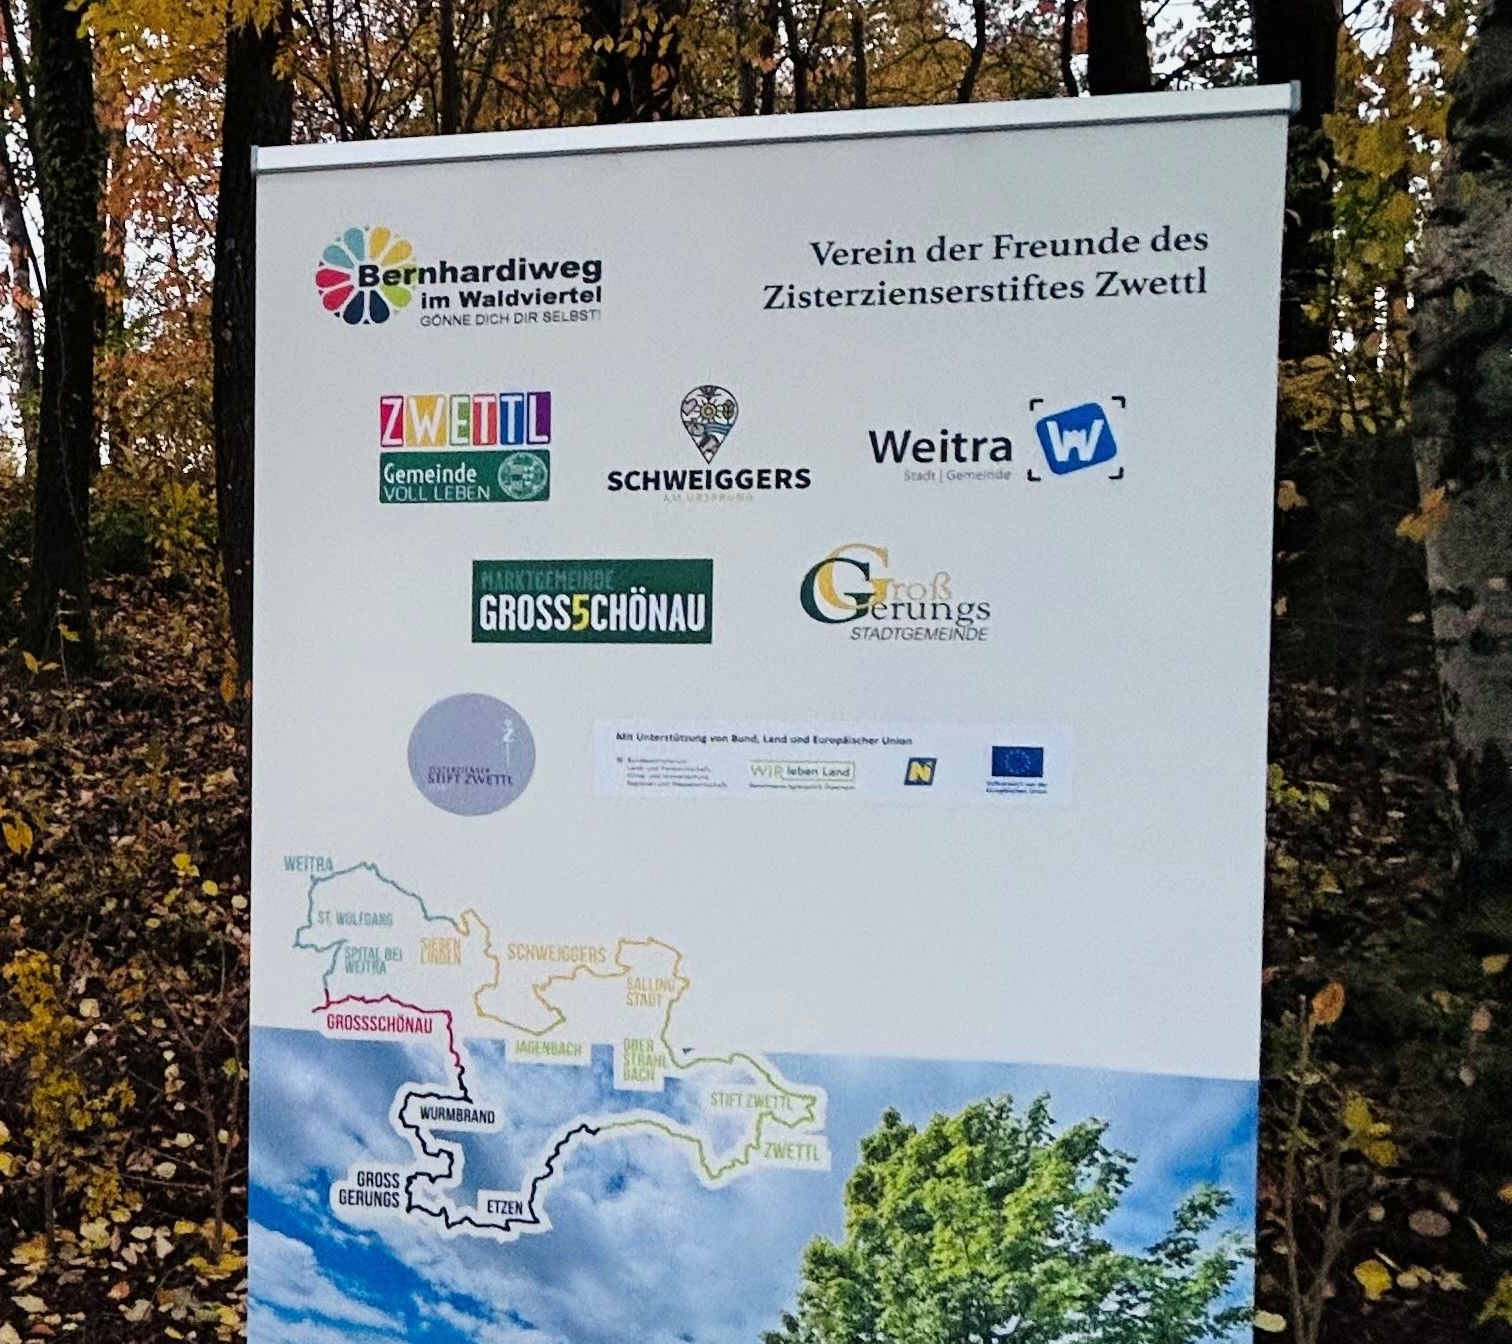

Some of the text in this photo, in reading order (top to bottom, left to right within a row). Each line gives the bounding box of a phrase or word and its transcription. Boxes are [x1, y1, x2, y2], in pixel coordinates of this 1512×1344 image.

[810, 224, 1209, 267] Verein der Freunde des
[358, 257, 603, 288] Bernhardiweg
[421, 285, 603, 309] im Waldviertel
[763, 267, 1207, 310] Zisterzienserstiftes Zwettl
[420, 311, 471, 327] GÖNNE
[476, 312, 509, 325] DICH
[514, 312, 538, 324] DIR
[381, 391, 550, 447] ZWETTL
[869, 429, 1013, 464] Weitra
[384, 463, 477, 485] Gemeinde
[607, 467, 811, 492] SCHWEIGGERS
[946, 469, 1012, 482] Gemeinde
[384, 485, 491, 502] VOLL LEBEN
[480, 567, 615, 591] MARKTGEMEINDE
[800, 557, 991, 627] Gerungs
[850, 627, 989, 641] STADTGEMEINDE
[710, 735, 728, 743] von
[790, 736, 810, 744] und
[284, 856, 334, 872] WEITRA
[326, 1013, 433, 1034] GROSSSCHÖNAU
[711, 1091, 742, 1107] STIFT
[420, 1106, 496, 1125] WURMBRAND
[765, 1142, 820, 1161] ZWETTL
[357, 1171, 400, 1189] GROSS
[339, 1189, 400, 1208] GERUNGS
[487, 1199, 524, 1216] ETZEN
